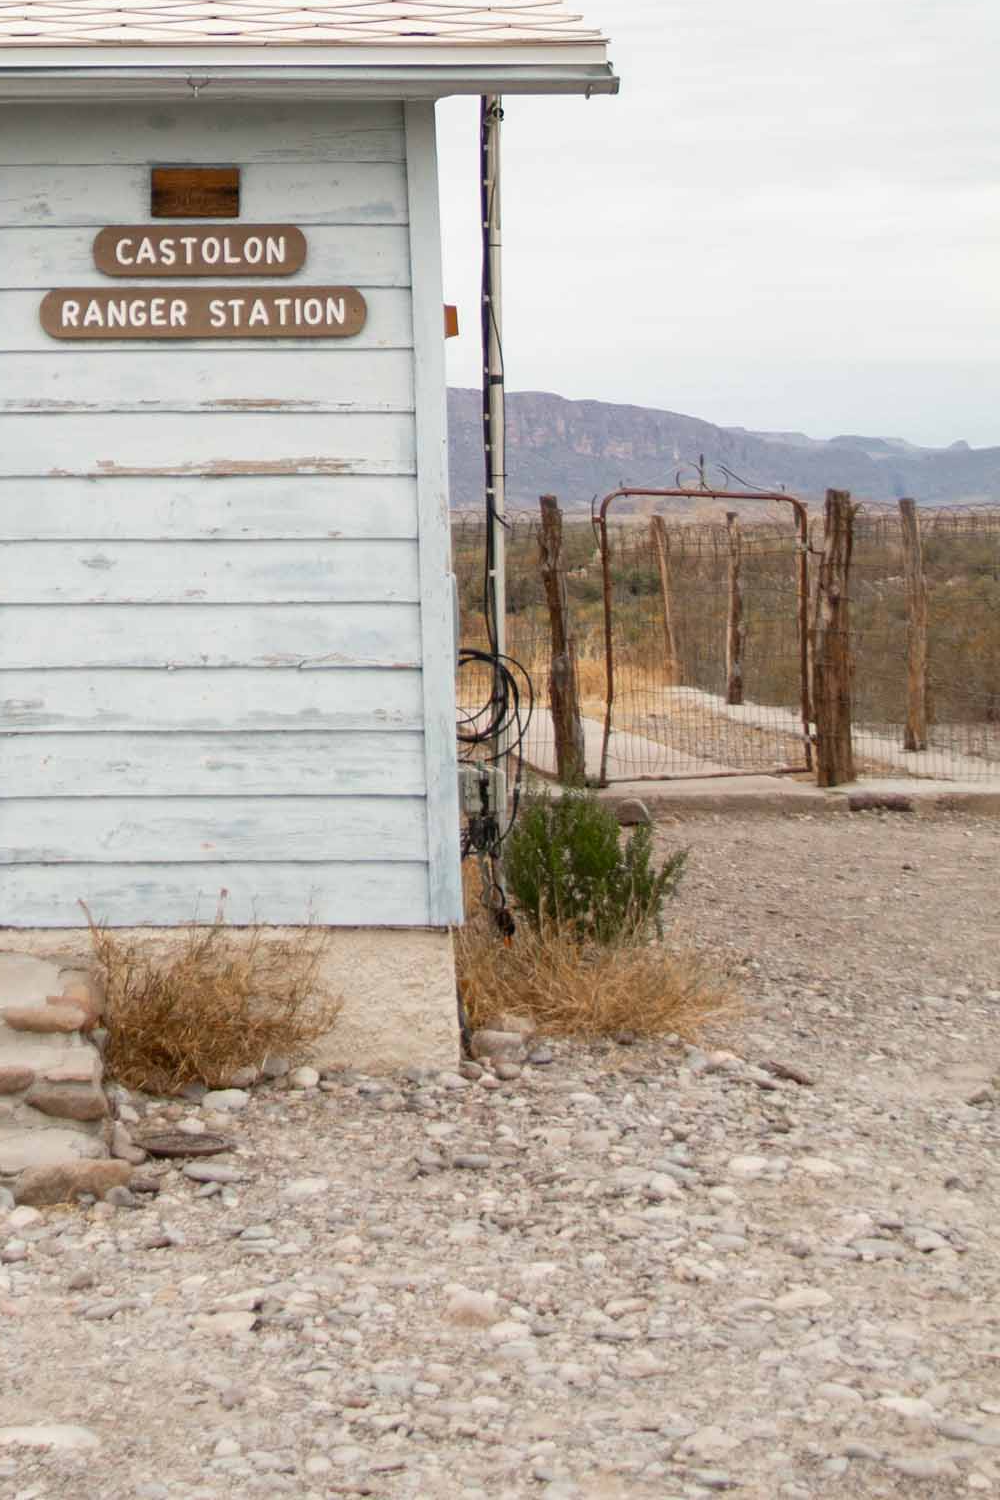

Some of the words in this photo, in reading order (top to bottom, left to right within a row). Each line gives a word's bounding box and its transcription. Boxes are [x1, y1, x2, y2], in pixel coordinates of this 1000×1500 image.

[115, 236, 286, 266] CASTOLON
[61, 298, 188, 327] RANGER
[209, 297, 346, 327] STATION
